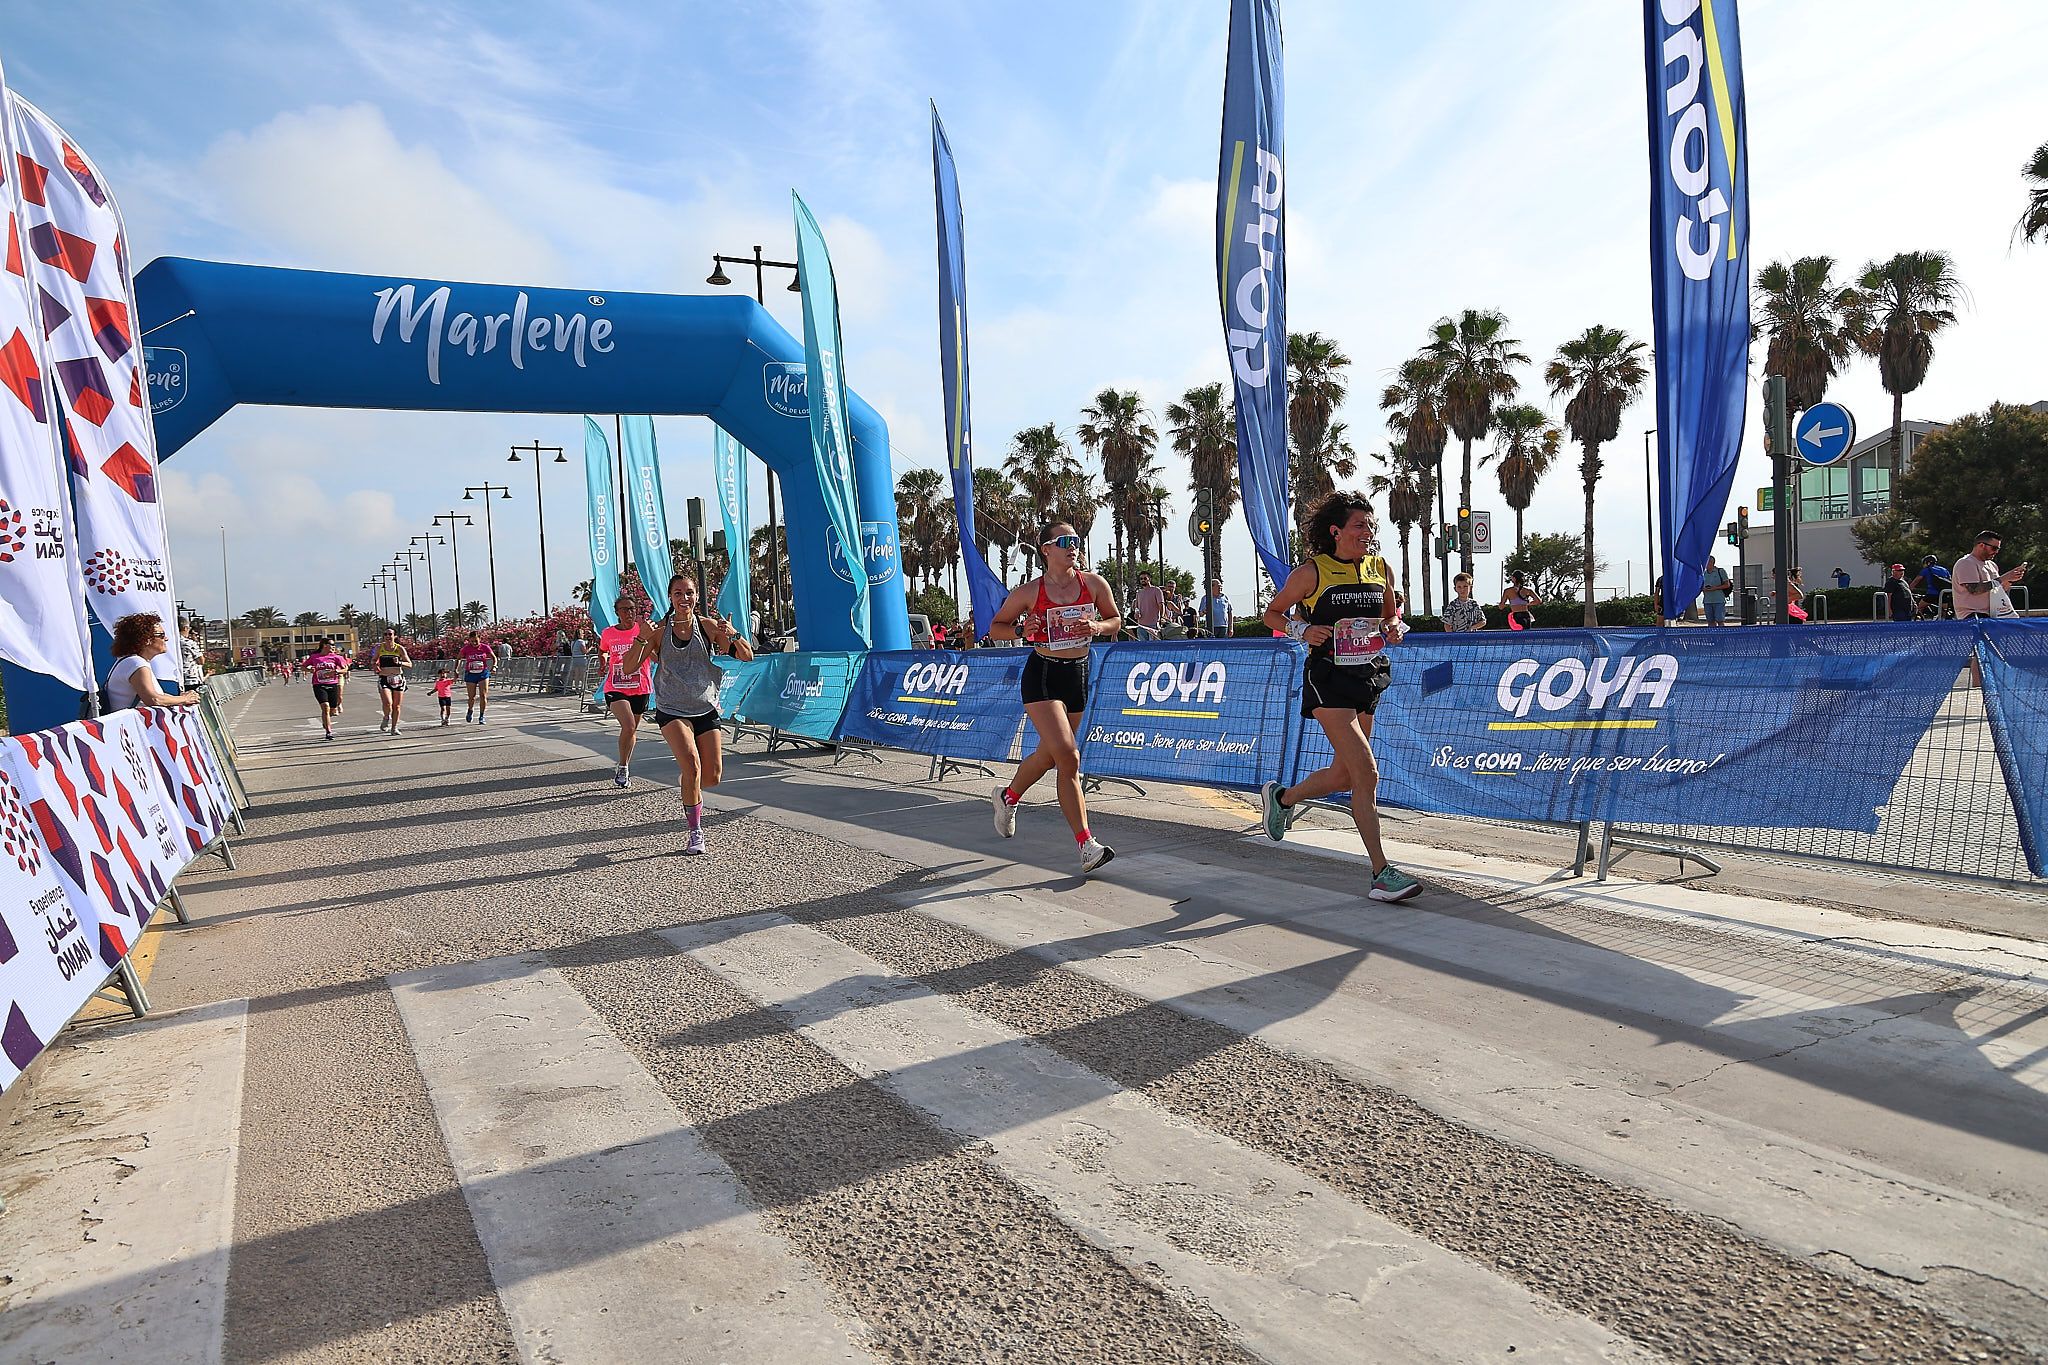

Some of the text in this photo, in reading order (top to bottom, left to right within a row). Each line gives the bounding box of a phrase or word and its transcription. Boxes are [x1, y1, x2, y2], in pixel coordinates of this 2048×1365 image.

[372, 284, 615, 385] Marlene
[770, 374, 808, 403] Marl
[1478, 528, 1486, 536] 30
[834, 535, 894, 562] rlene
[1331, 592, 1362, 601] PATERNA
[1352, 635, 1371, 647] 016
[780, 672, 824, 700] Compeed
[903, 662, 969, 694] GOYA
[1126, 661, 1226, 706] GOYA
[1497, 654, 1679, 718] GOYA
[887, 712, 907, 724] GOYA
[1087, 725, 1103, 742] ¡Si
[1103, 732, 1113, 744] es
[1115, 730, 1145, 745] GOYA
[1175, 738, 1194, 759] que
[1196, 738, 1215, 751] ser
[1216, 731, 1257, 755] bueno!
[1430, 745, 1452, 768] ¡Si
[1453, 755, 1473, 769] es
[1474, 752, 1521, 770] GOYA
[1571, 755, 1602, 784] que
[1607, 755, 1641, 772] ser
[1642, 745, 1725, 775] bueno!
[29, 885, 65, 916] Experience
[57, 935, 93, 982] OMAN
